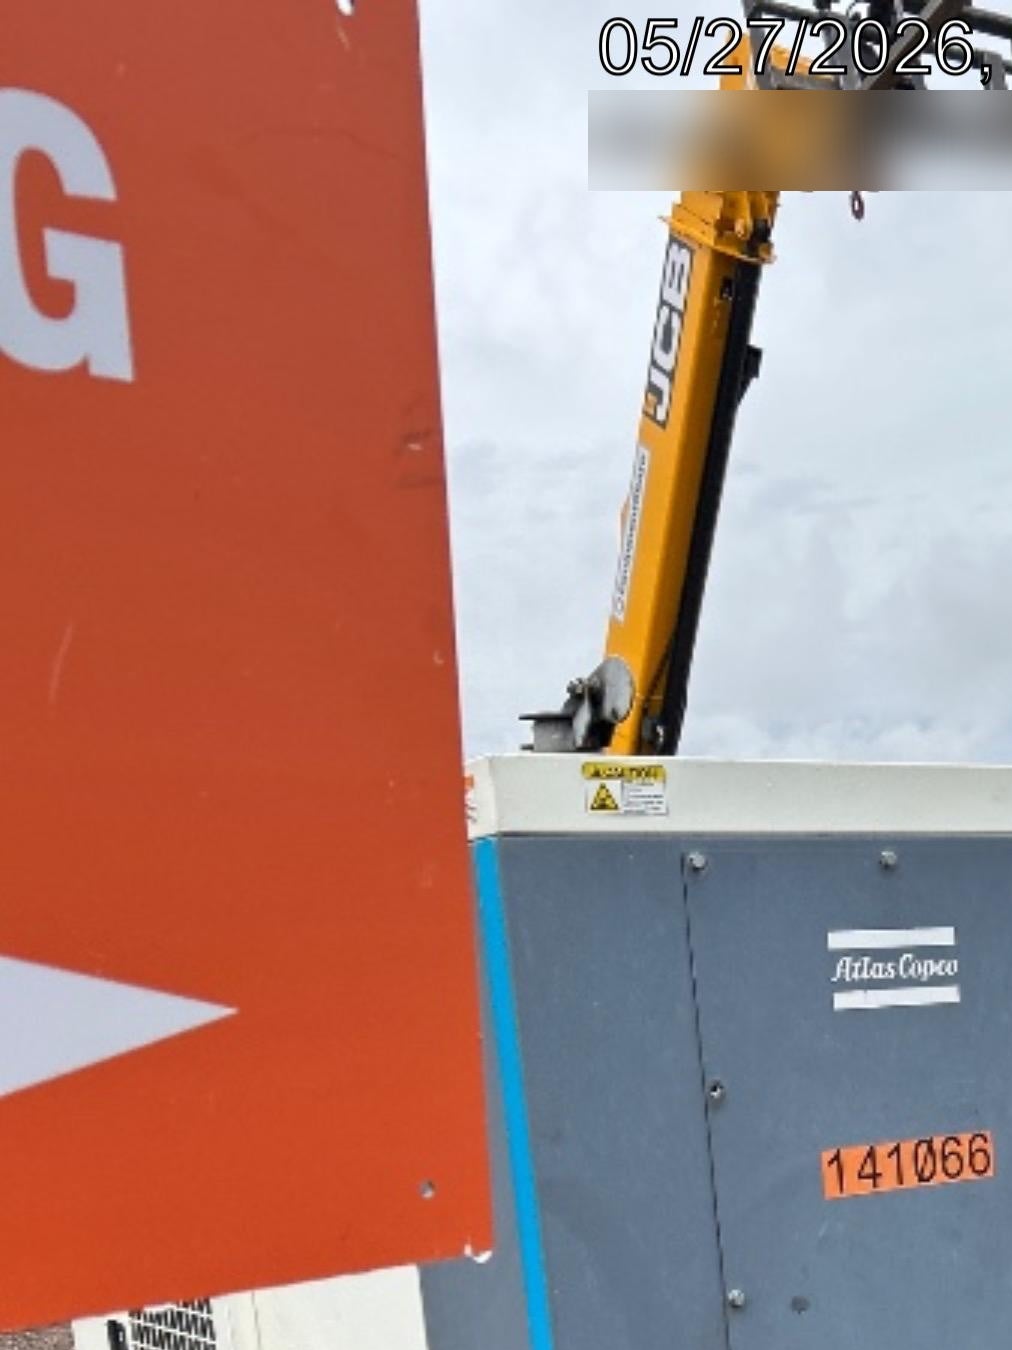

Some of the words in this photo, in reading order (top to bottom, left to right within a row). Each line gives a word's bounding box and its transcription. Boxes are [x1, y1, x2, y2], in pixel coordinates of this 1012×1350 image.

[645, 236, 693, 429] JCB
[831, 955, 896, 982] Atlas
[899, 952, 960, 982] Copco
[827, 1132, 991, 1194] 141066
